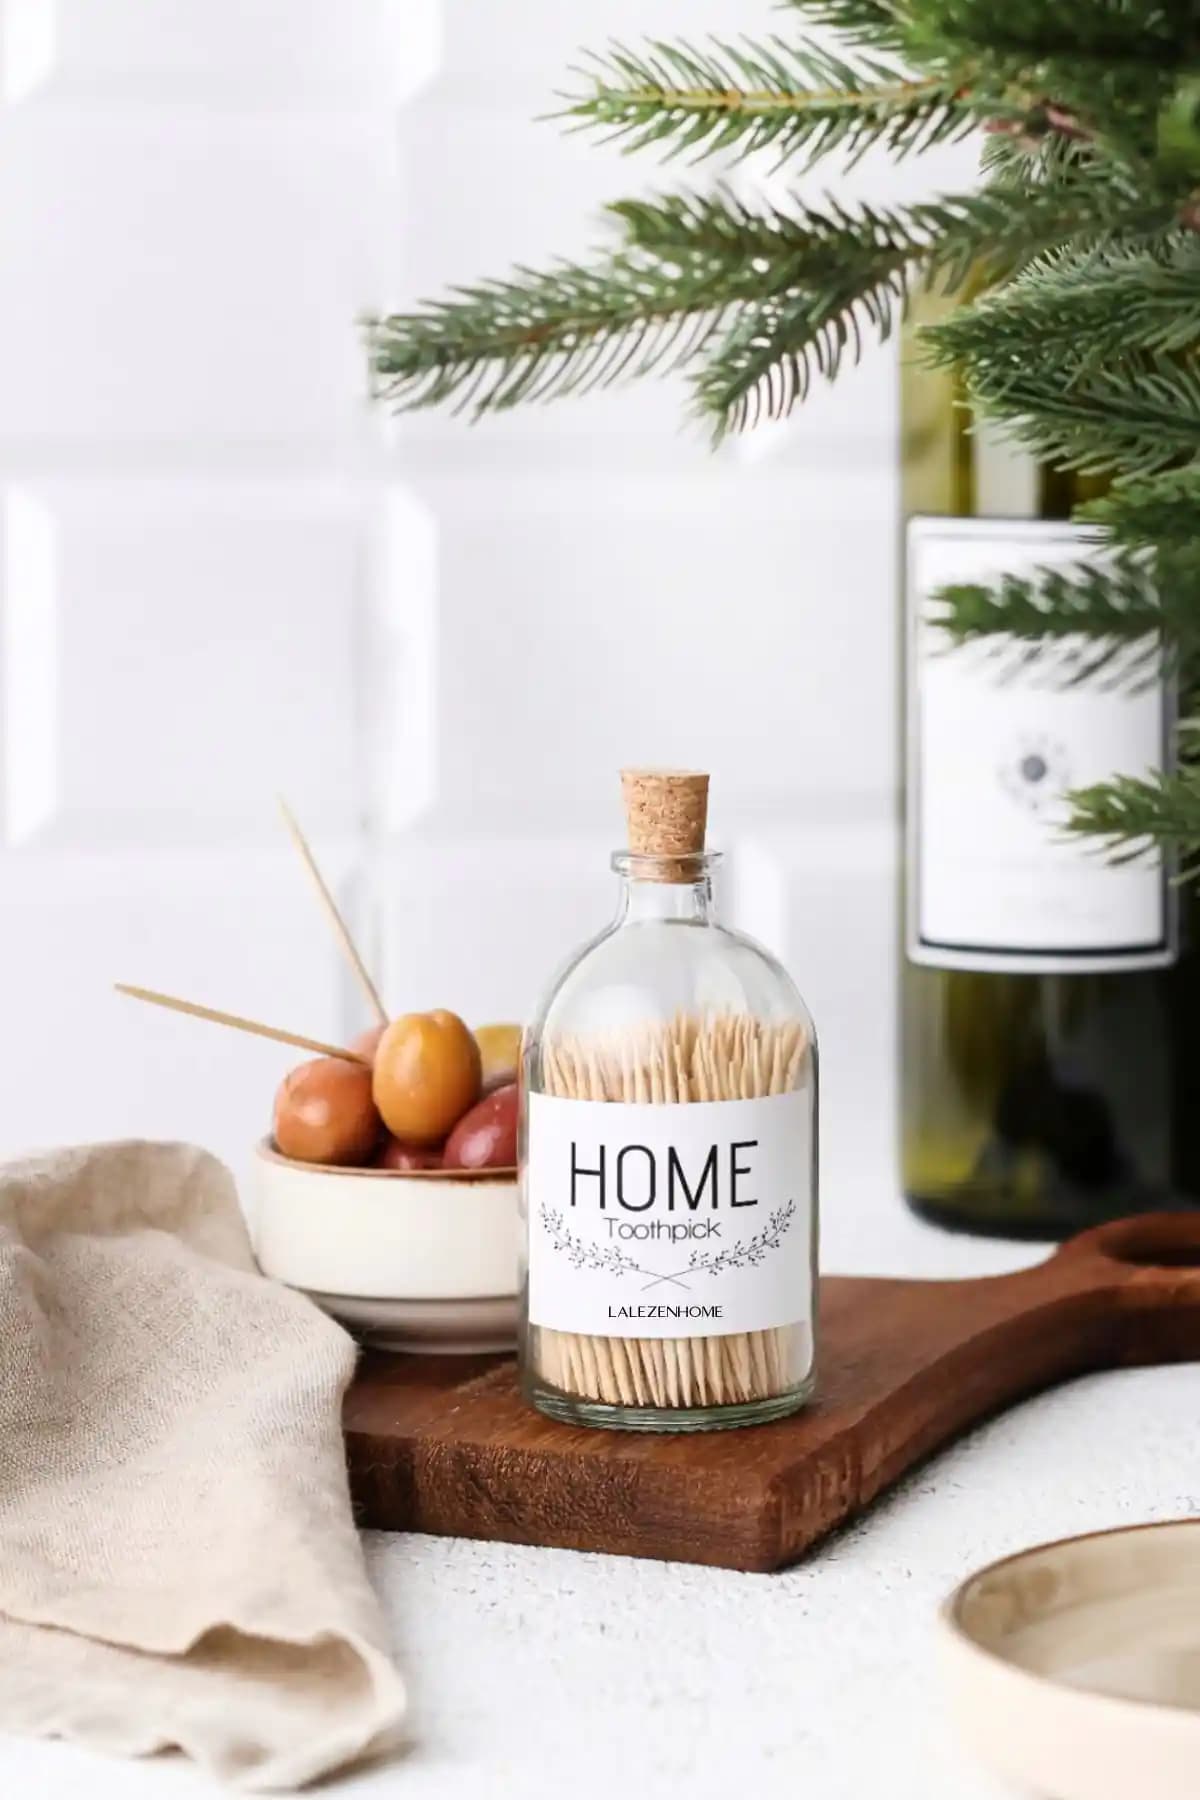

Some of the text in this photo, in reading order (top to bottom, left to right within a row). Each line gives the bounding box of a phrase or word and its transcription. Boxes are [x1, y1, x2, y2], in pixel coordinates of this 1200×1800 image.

[570, 1140, 759, 1212] HOME
[603, 1217, 722, 1244] Toothpick
[607, 1305, 724, 1318] LALEZENHOME
